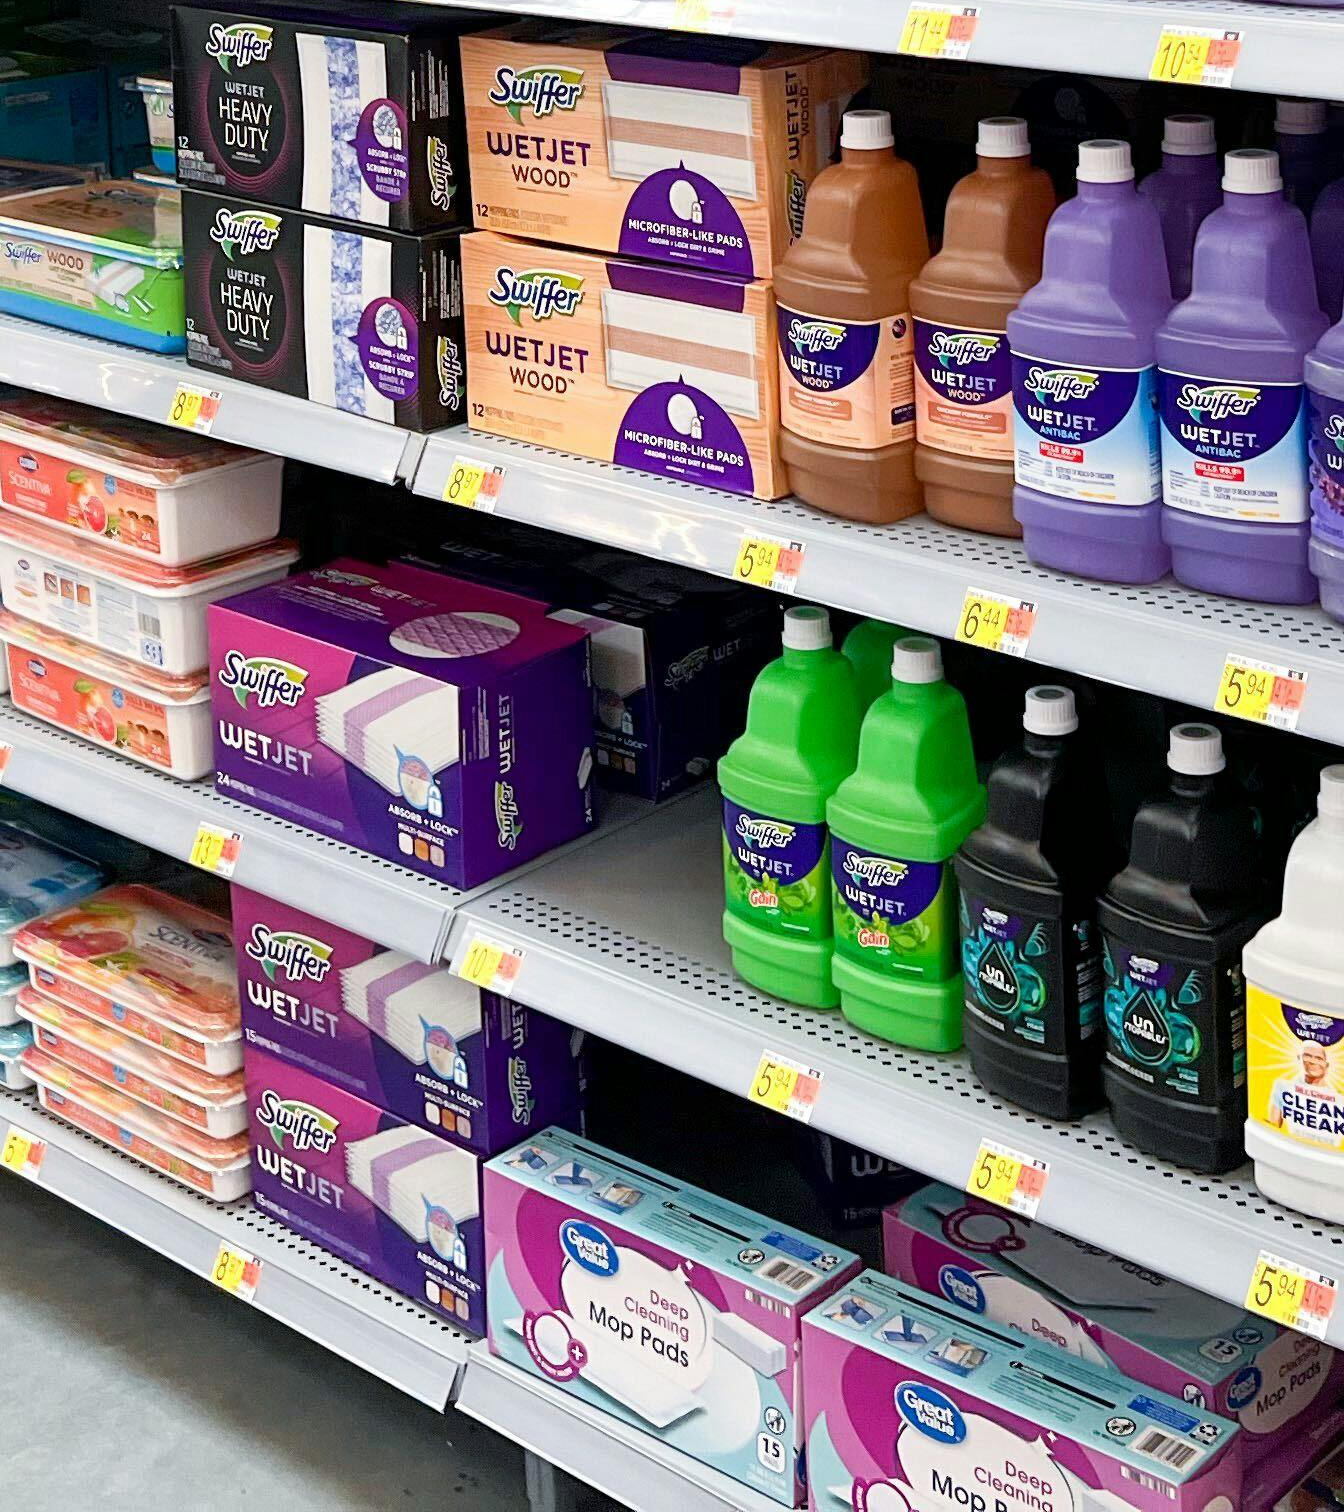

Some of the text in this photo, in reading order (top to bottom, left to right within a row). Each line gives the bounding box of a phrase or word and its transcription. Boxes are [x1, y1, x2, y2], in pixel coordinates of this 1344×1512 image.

[476, 204, 489, 217] 12
[210, 210, 282, 255] Swiffer
[47, 252, 85, 270] WOOD
[227, 268, 266, 287] WETJET
[221, 286, 274, 314] HEAVY
[489, 266, 586, 316] Swiffer
[225, 310, 270, 340] DUTY
[1028, 406, 1095, 429] WETJET
[624, 429, 744, 466] MICROFIBER-LIKE PADS
[1195, 445, 1241, 459] ANTIBAC
[218, 719, 314, 776] WETJET
[217, 772, 231, 787] 24
[749, 890, 777, 907] Gain
[845, 885, 906, 916] WETJET
[859, 929, 888, 947] Gain
[415, 1072, 445, 1089] ABSORB
[456, 1094, 480, 1111] LOCK
[254, 1090, 341, 1144] Swiffer
[256, 1145, 345, 1209] WETJET
[623, 1292, 692, 1343] Cleaning
[649, 1289, 690, 1323] Deep
[589, 1300, 691, 1368] Mop Pads
[1256, 1359, 1323, 1417] Mop Pads
[902, 1387, 954, 1431] Great
[911, 1407, 959, 1442] Value
[764, 1439, 781, 1459] 15
[974, 1465, 1054, 1511] Cleaning
[1003, 1459, 1054, 1496] Deep
